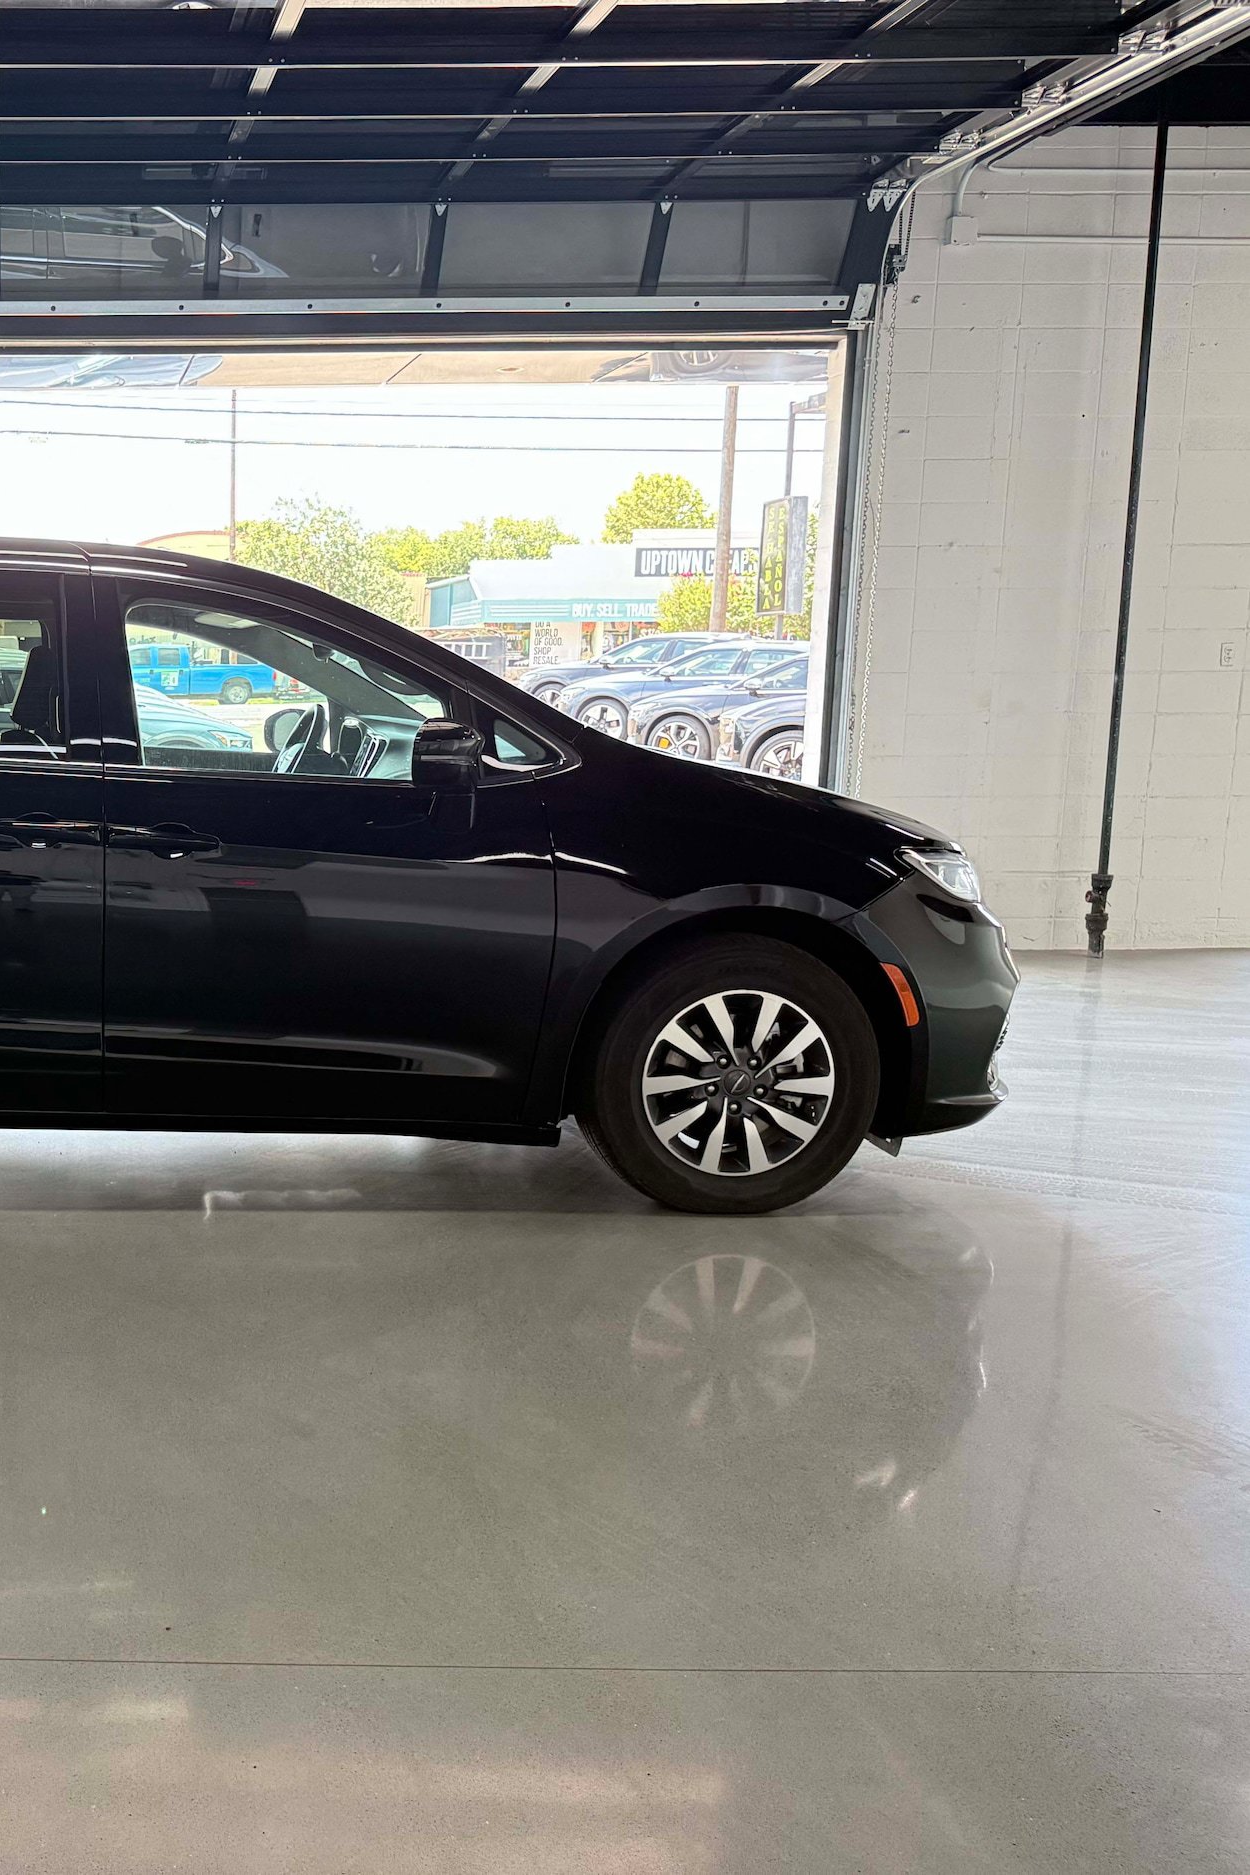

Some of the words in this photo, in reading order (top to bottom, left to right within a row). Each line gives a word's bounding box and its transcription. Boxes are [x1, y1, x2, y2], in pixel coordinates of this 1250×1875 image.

[640, 550, 704, 575] UPTOWN
[773, 507, 786, 607] ESPAÑOL
[762, 542, 775, 610] HABLA
[534, 628, 558, 637] WORLD
[534, 637, 542, 646] OF
[533, 646, 551, 655] SHOP
